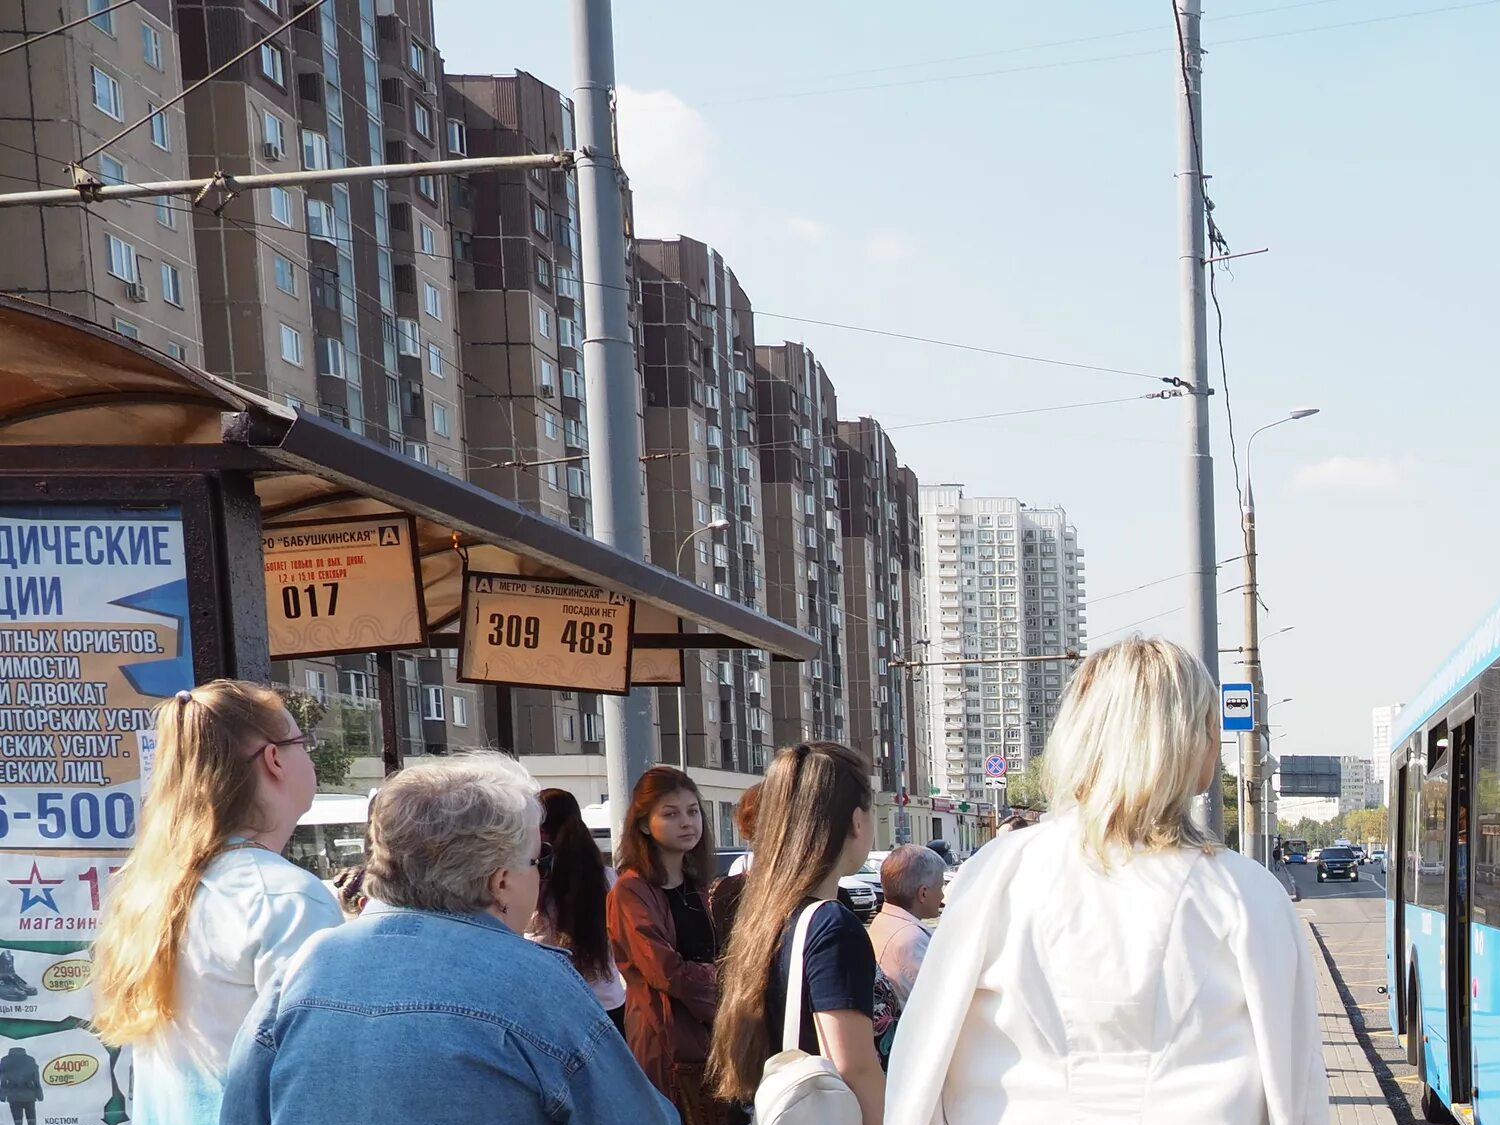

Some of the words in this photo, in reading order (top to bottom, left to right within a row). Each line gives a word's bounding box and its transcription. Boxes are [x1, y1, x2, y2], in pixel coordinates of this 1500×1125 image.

[500, 581, 527, 593] МЕТРО
[282, 582, 339, 619] 017
[563, 604, 600, 617] ПОСАДКИ
[601, 608, 617, 618] НЕТ
[0, 630, 58, 653] ТНЫХ
[63, 630, 164, 653] ЮРИСТОВ.
[488, 613, 540, 649] 309
[561, 620, 613, 656] 483
[16, 682, 107, 708] АДВОКАТ
[0, 735, 56, 757] СКИХ
[62, 762, 111, 786] ЛИЦ.
[44, 1117, 79, 1125] КОСТЮМ
